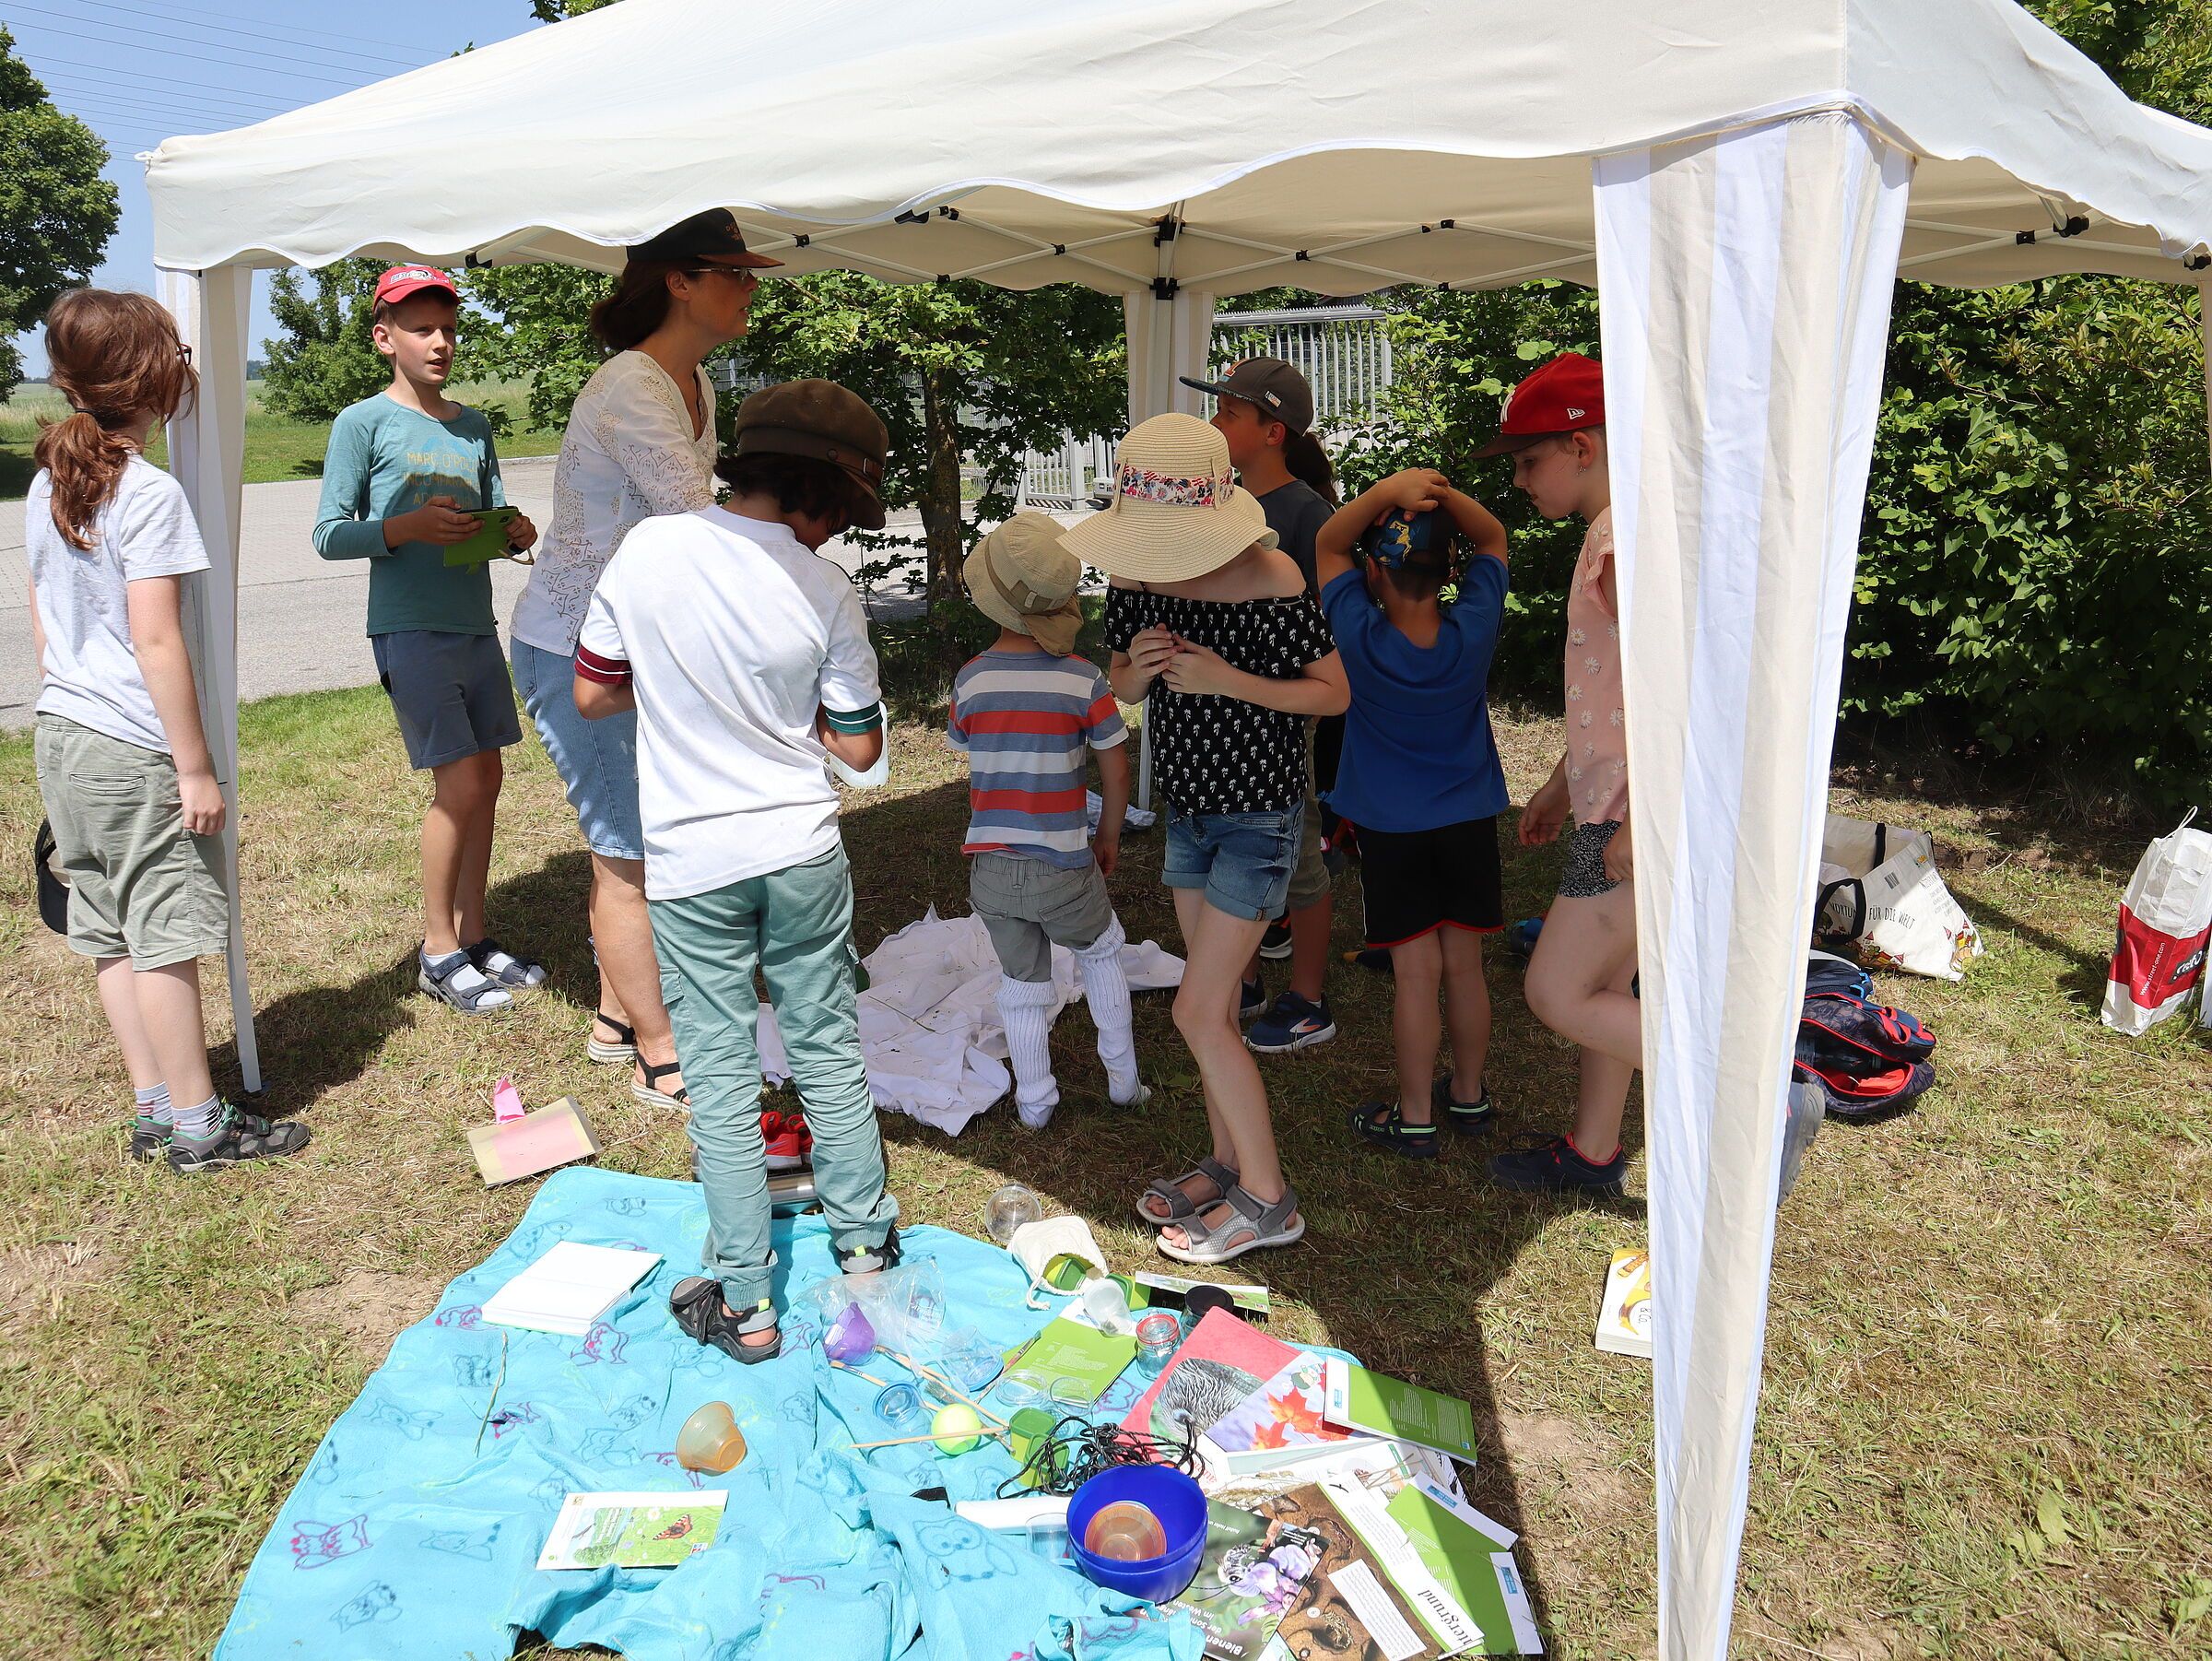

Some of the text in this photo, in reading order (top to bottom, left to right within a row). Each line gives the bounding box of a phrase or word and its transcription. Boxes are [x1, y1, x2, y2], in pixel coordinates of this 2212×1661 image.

[1868, 904, 1882, 921] FÜR
[1884, 907, 1896, 923] DIE
[1899, 911, 1915, 929] WELT
[2139, 942, 2166, 996] www.street-one.com
[1207, 1624, 1222, 1634] der
[1206, 1635, 1243, 1655] Bienen
